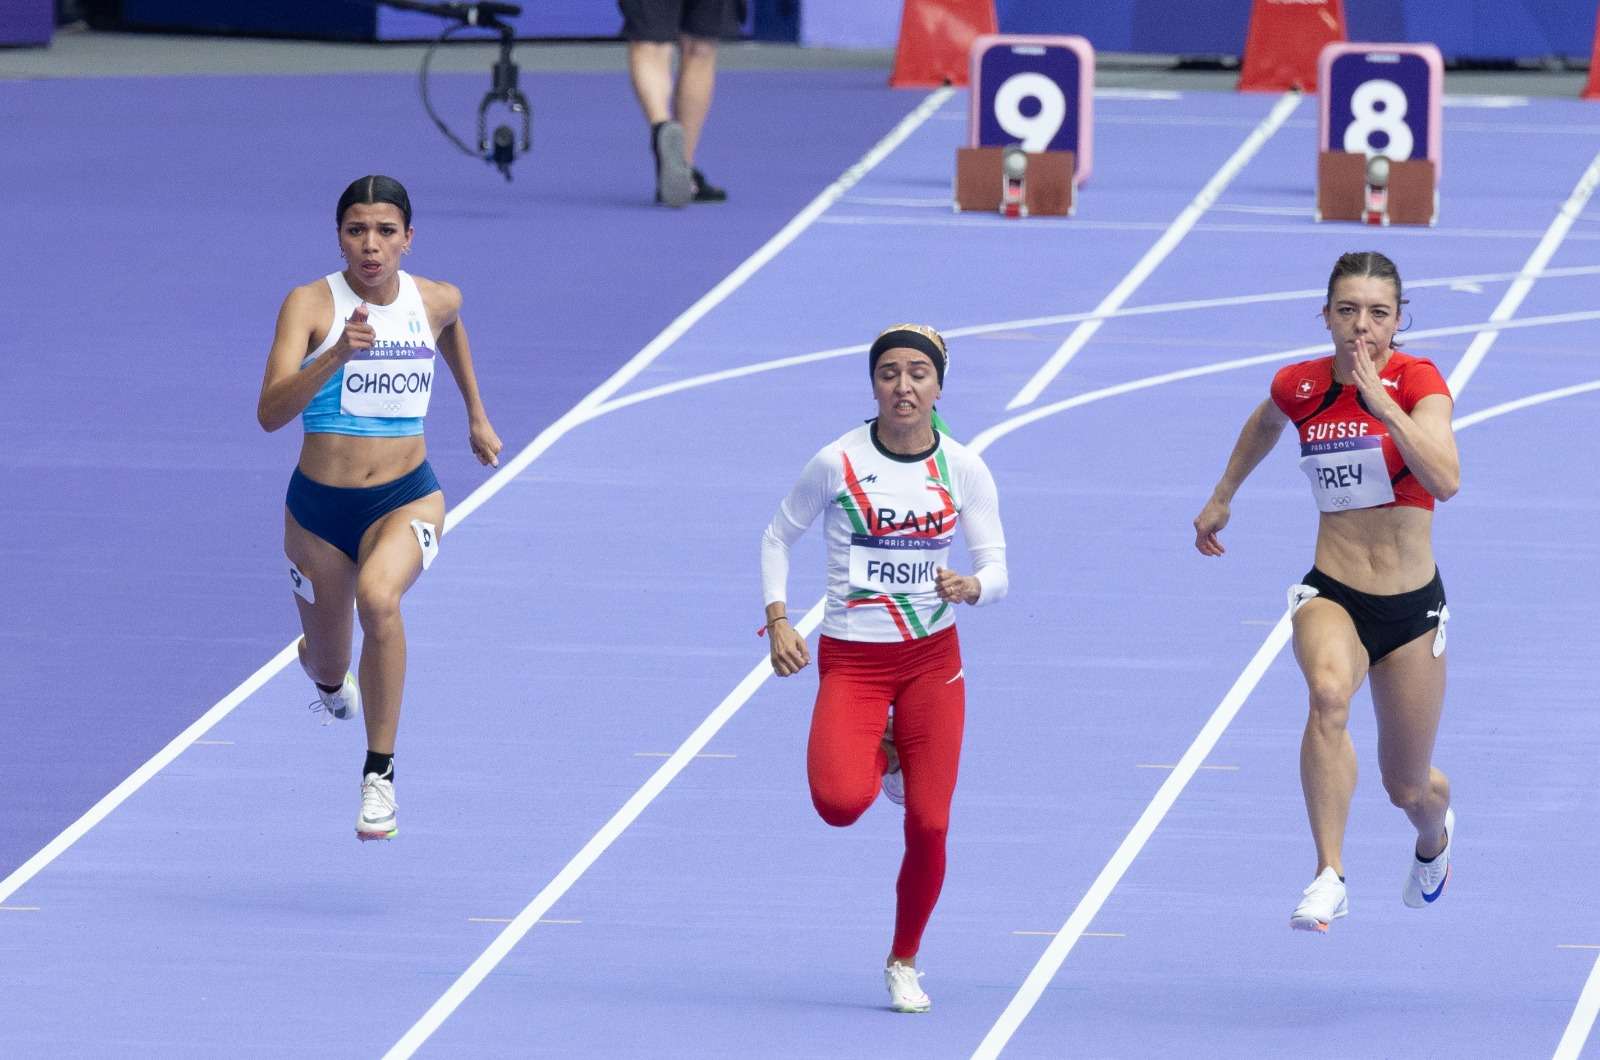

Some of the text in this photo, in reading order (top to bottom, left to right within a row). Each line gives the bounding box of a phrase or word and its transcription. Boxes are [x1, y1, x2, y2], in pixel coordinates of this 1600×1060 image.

[994, 71, 1066, 154] 9
[1343, 79, 1414, 162] 8
[370, 349, 394, 357] PARIS
[346, 372, 431, 394] CHACON
[1315, 463, 1362, 489] FREY
[866, 507, 944, 534] IRAN
[878, 538, 905, 547] PARIS
